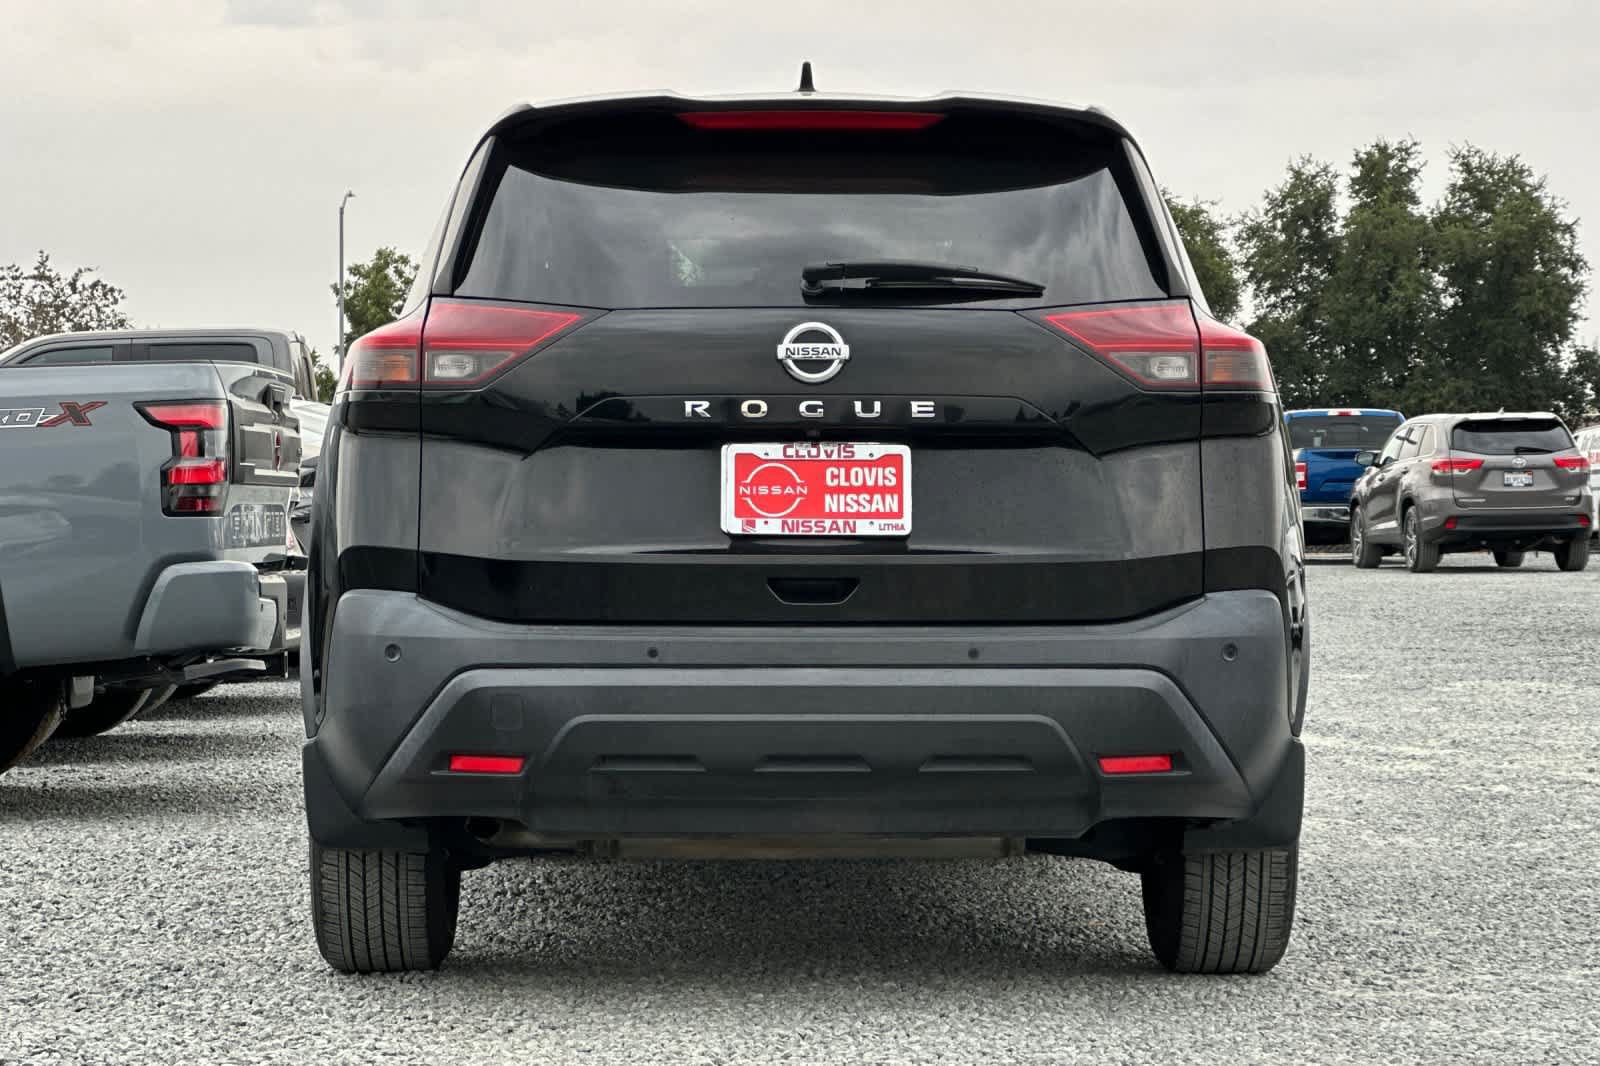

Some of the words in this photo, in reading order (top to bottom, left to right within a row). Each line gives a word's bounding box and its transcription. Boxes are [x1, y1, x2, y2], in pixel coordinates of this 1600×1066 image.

[785, 347, 841, 356] NISSAN
[684, 400, 936, 418] ROGUE
[782, 443, 855, 458] CLOVIS
[826, 467, 897, 487] CLOVIS
[739, 485, 808, 495] NISSAN
[824, 494, 898, 513] NISSAN
[781, 520, 856, 533] NISSAN
[879, 523, 906, 531] LITHIA
